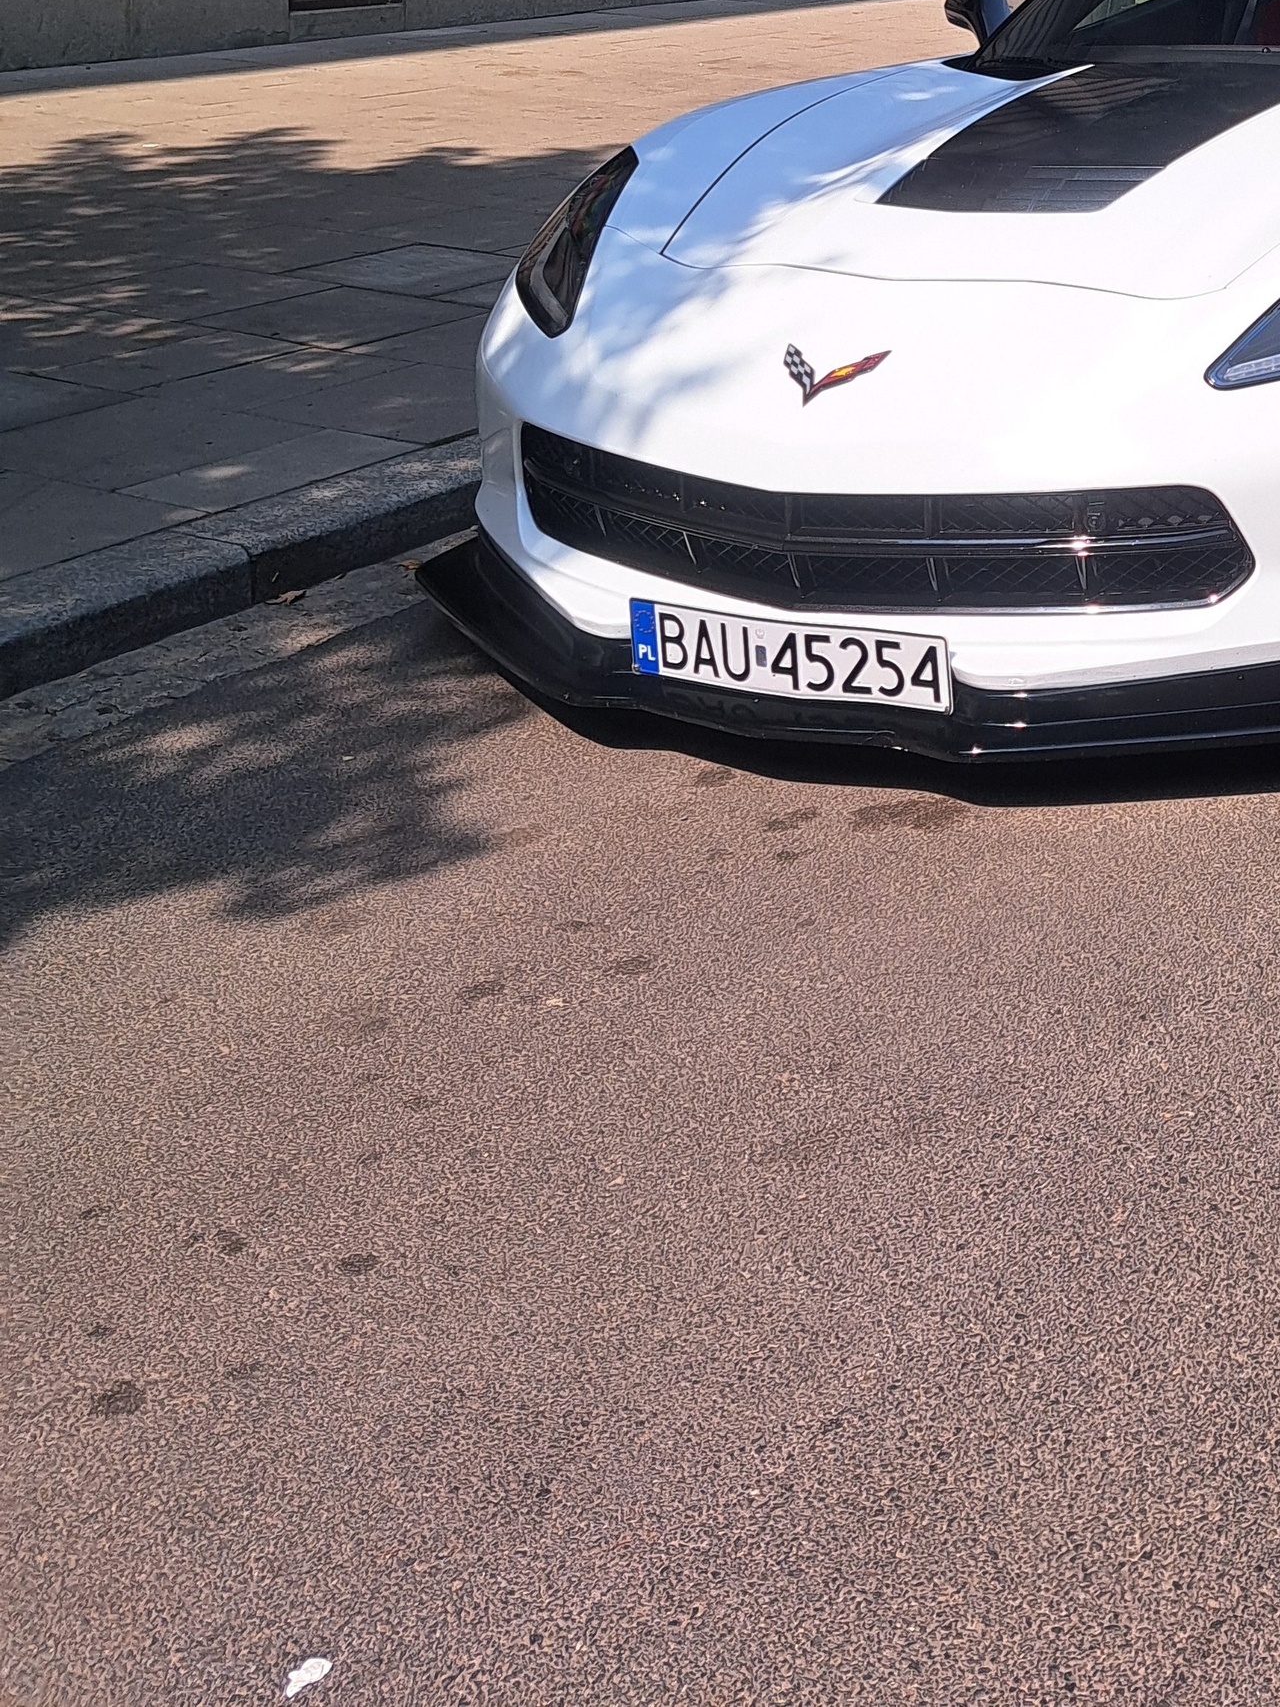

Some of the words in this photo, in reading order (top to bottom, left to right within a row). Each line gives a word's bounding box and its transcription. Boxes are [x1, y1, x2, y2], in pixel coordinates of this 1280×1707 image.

[638, 644, 656, 661] PL
[658, 611, 751, 682] BAU
[771, 631, 943, 704] 45254
